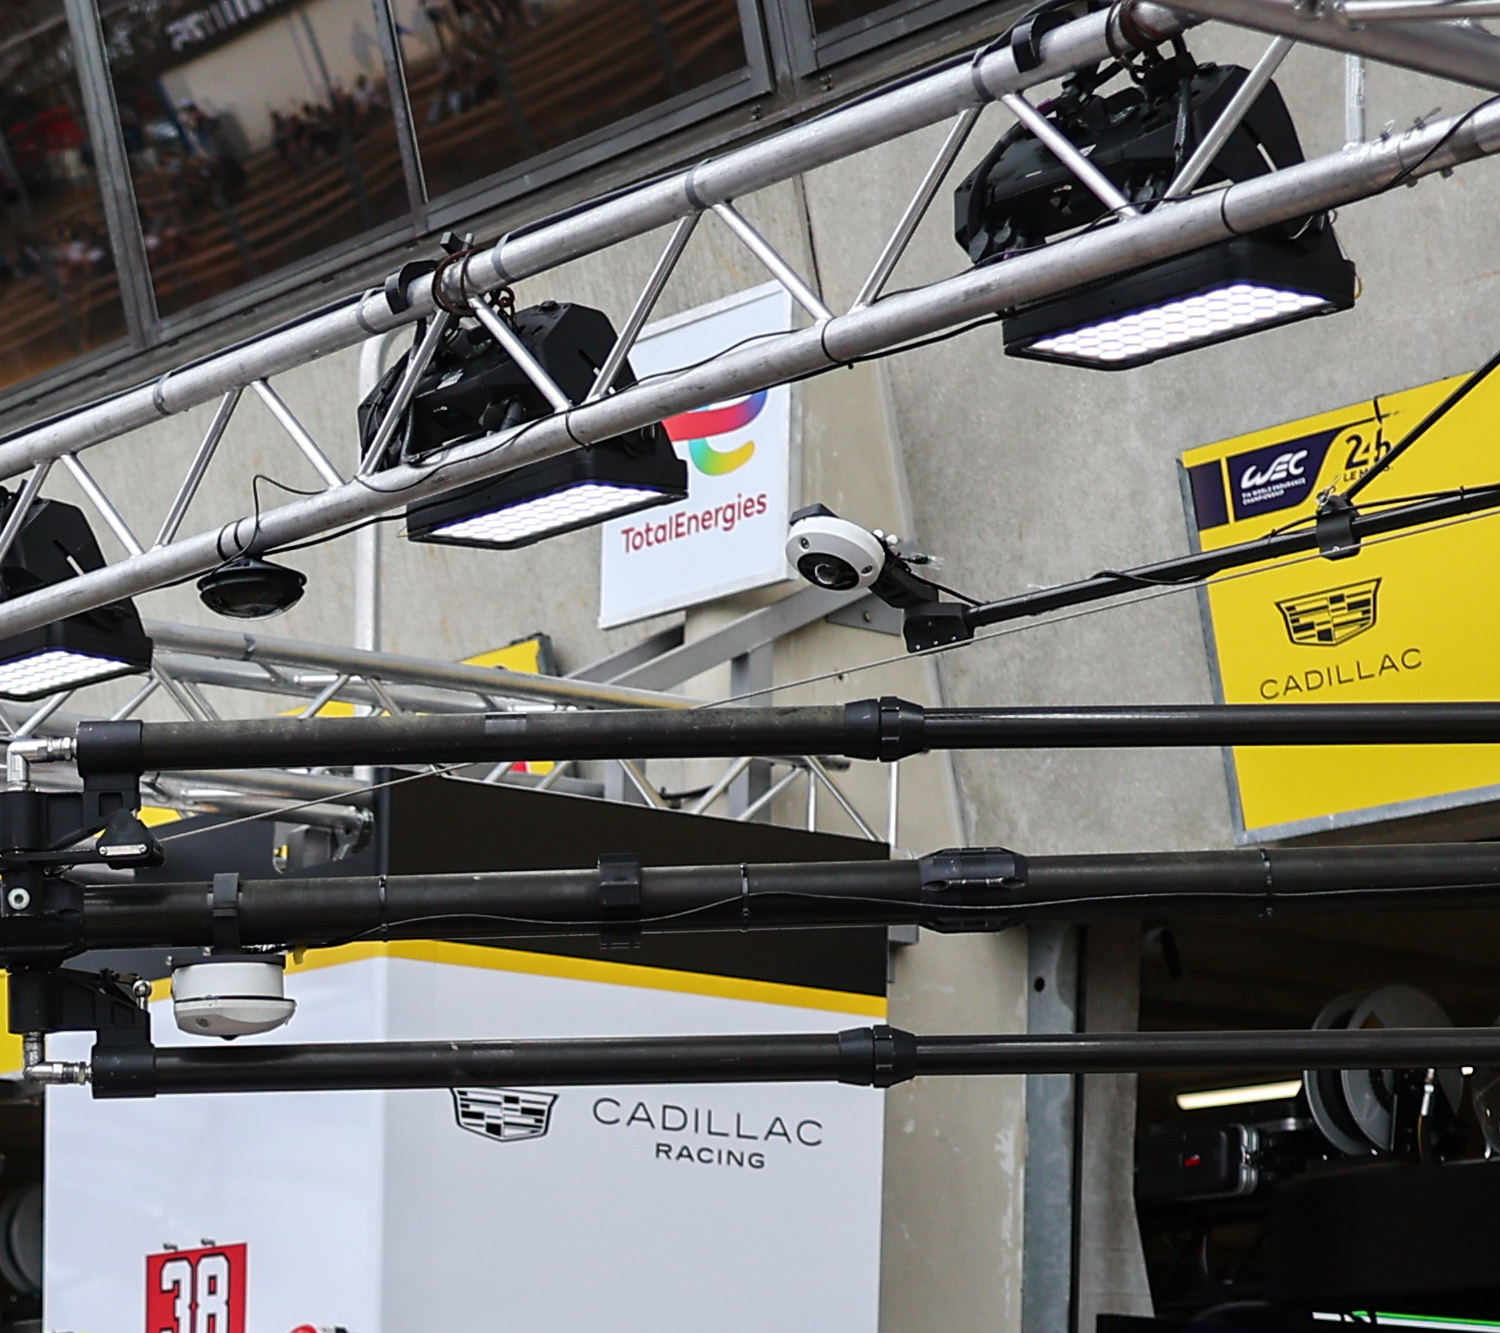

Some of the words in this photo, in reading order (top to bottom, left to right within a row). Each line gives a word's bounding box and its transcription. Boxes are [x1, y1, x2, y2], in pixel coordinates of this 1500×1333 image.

[1241, 450, 1308, 489] WEC
[1345, 427, 1392, 470] 24h
[621, 492, 767, 554] TotalEnergies
[1260, 648, 1422, 700] CADILLAC
[592, 1096, 824, 1150] CADILLAC
[654, 1143, 765, 1170] RACING
